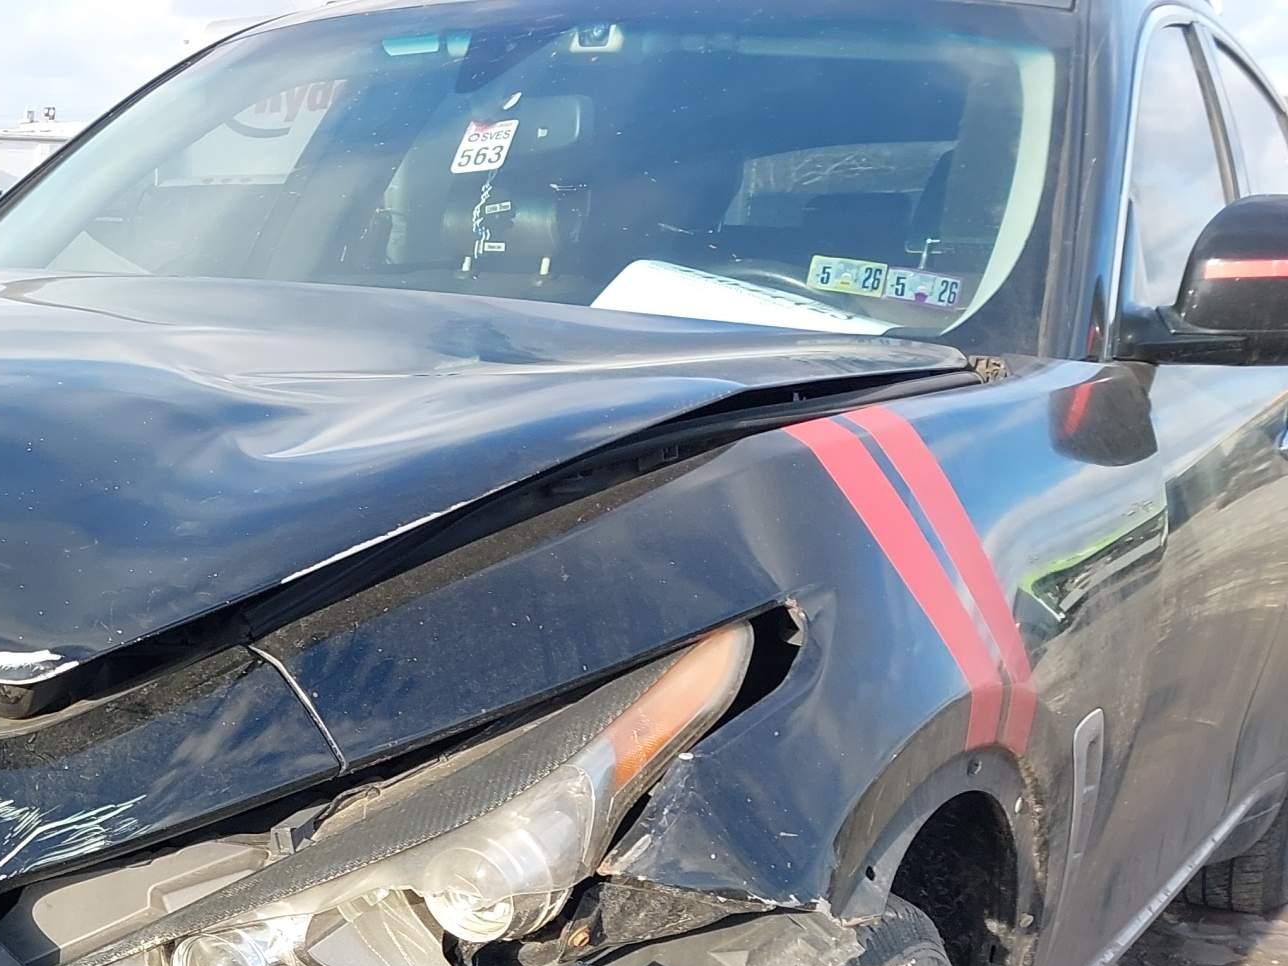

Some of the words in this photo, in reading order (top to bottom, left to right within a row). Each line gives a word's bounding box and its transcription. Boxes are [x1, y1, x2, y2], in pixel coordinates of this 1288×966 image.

[457, 145, 504, 168] 563
[862, 266, 882, 291] 26
[938, 279, 958, 304] 26
